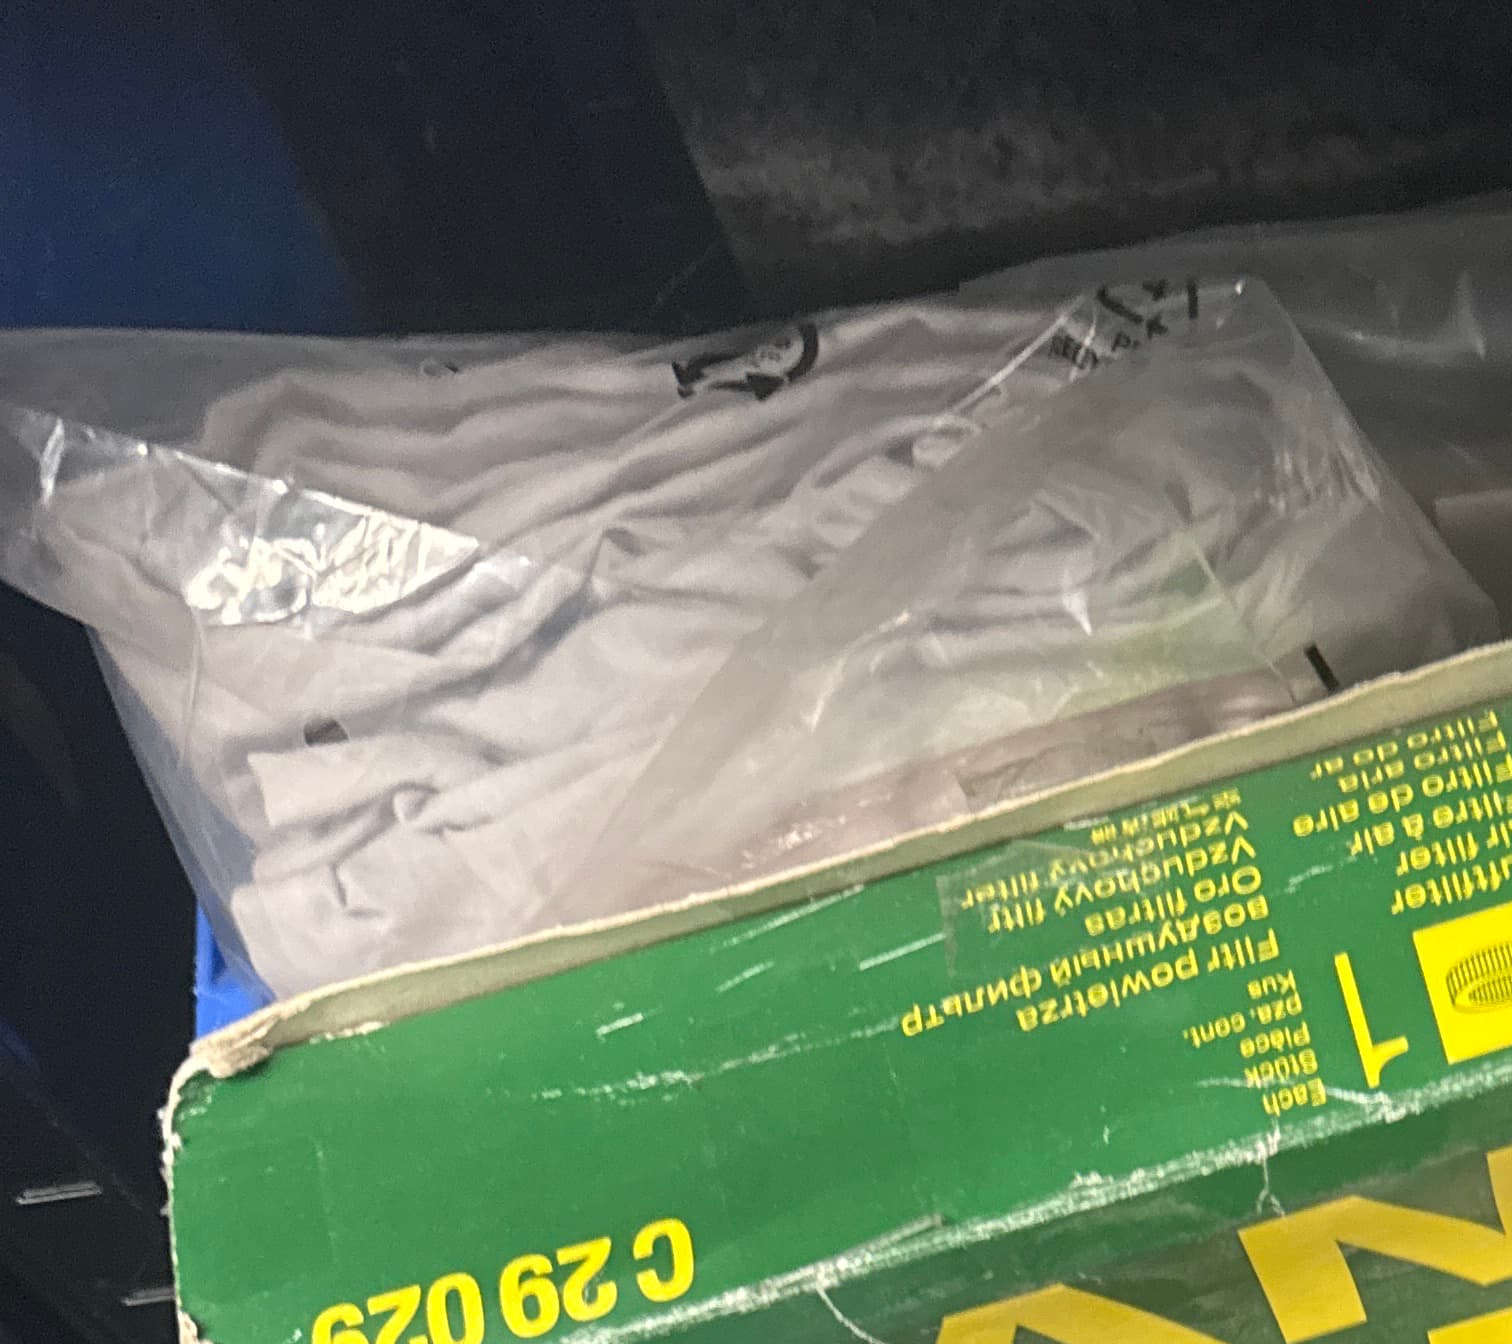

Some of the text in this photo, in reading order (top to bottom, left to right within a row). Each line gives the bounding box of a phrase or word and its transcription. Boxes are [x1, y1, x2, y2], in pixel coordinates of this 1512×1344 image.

[1338, 730, 1506, 792] Filtro aria
[1293, 800, 1359, 836] aire
[1368, 784, 1413, 813] de
[1347, 822, 1394, 857] air
[1397, 832, 1479, 876] filter
[961, 871, 1039, 908] filter
[989, 836, 1256, 932] Vzduchový filtr
[1085, 866, 1261, 936] Oro filtras
[901, 895, 1268, 1036] воздушный фильтр
[1016, 928, 1279, 1031] Filtr powietrza
[1248, 970, 1296, 999] Kus
[1335, 952, 1408, 1088] 1
[1263, 1078, 1326, 1116] Each
[499, 1237, 617, 1338] 29
[633, 1219, 694, 1302] C
